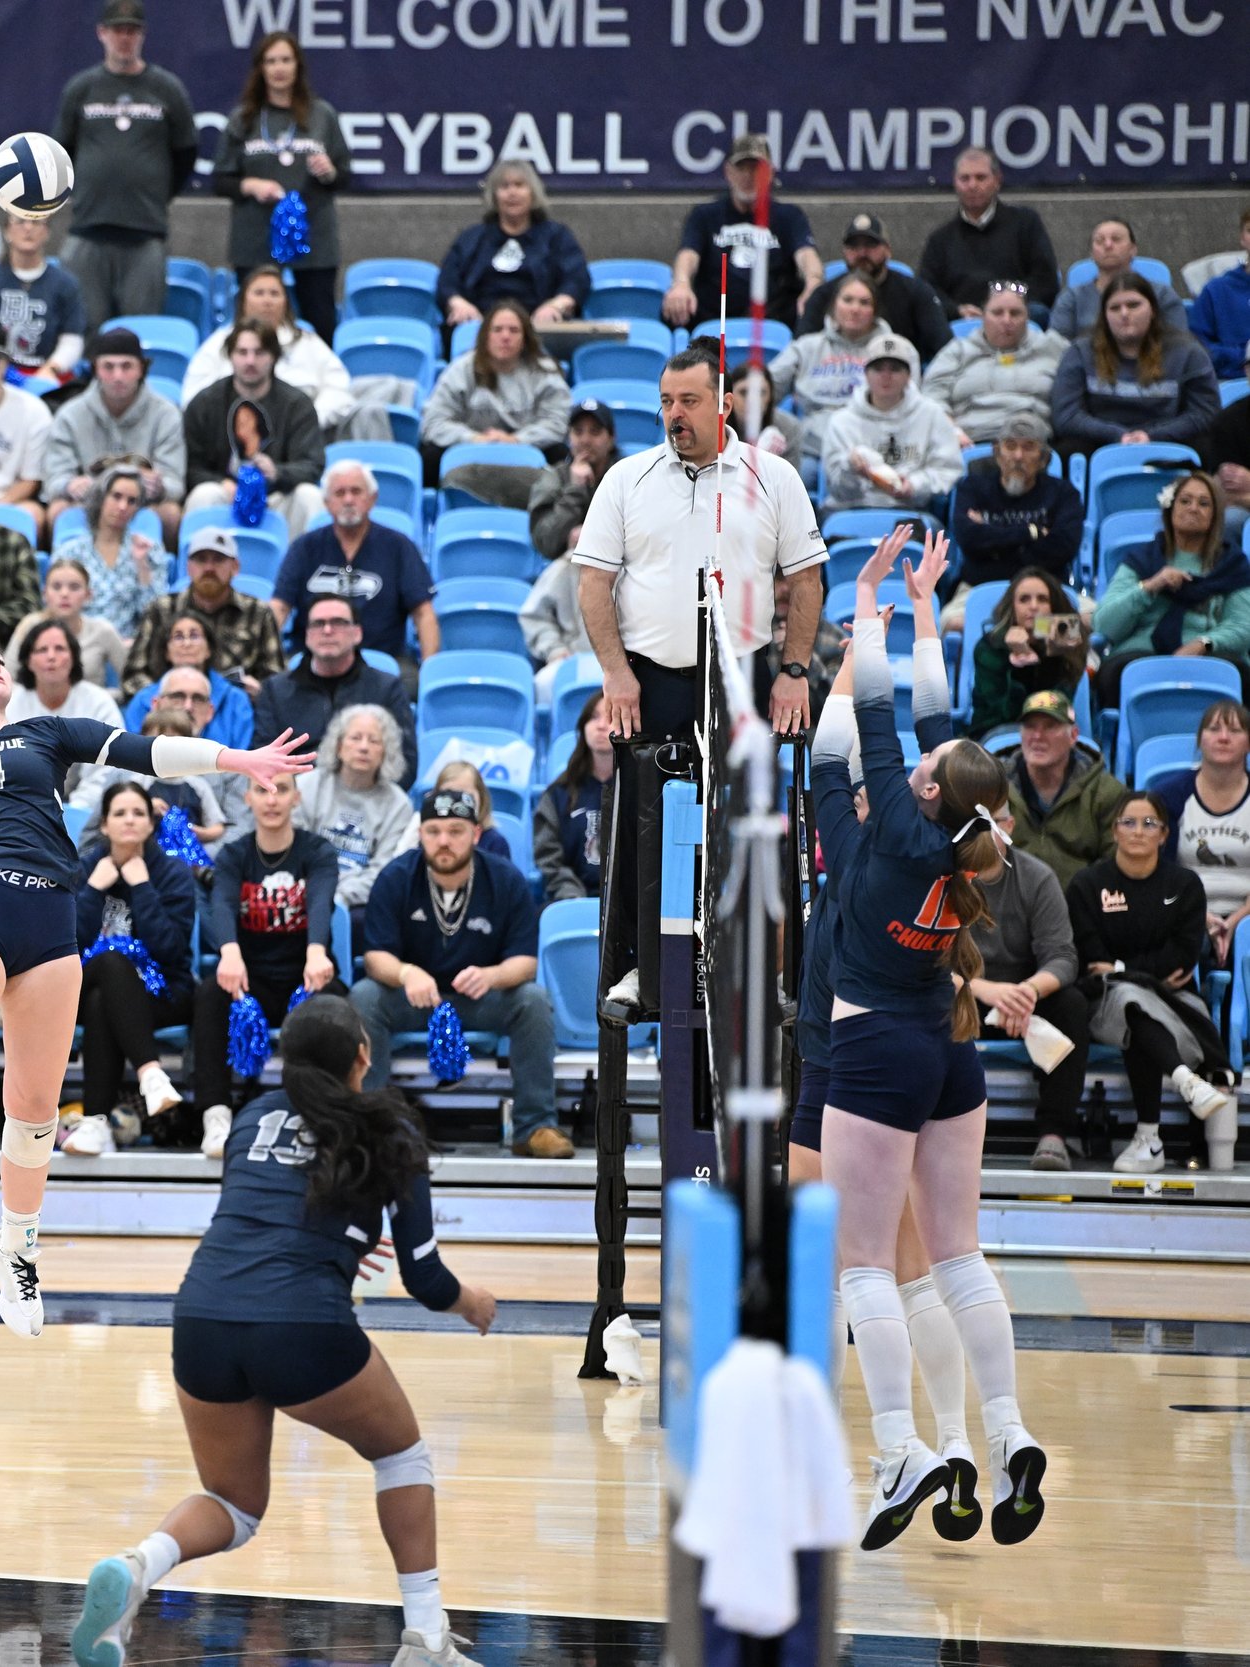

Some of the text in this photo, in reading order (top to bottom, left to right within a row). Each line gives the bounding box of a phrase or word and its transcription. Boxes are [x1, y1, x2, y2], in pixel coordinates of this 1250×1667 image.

[223, 0, 1225, 50] WELCOME TO THE NWAC
[193, 111, 649, 176] OEYBALL
